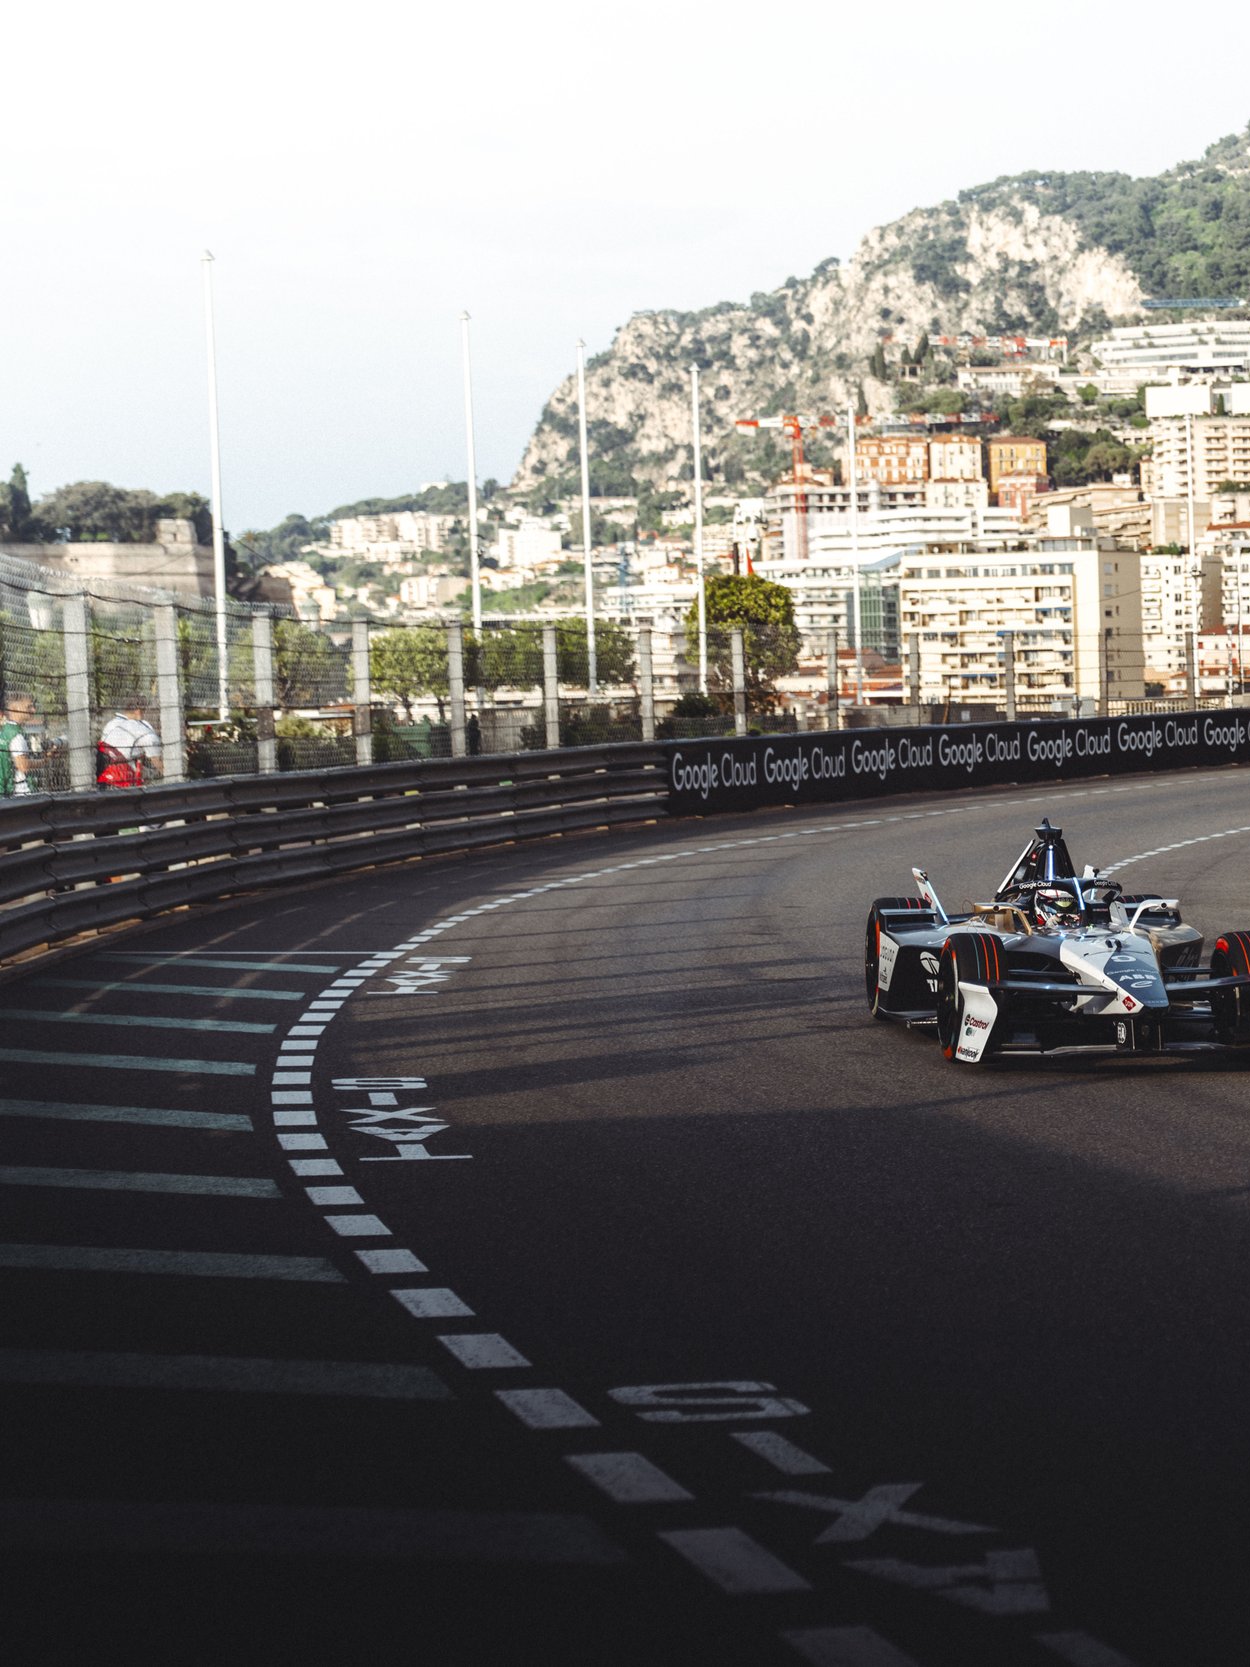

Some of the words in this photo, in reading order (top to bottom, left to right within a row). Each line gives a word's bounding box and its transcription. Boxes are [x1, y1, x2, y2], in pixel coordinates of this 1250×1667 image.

[939, 733, 983, 772] Google
[985, 732, 1020, 763] Cloud
[1027, 729, 1072, 767] Google
[1075, 728, 1111, 756] Cloud
[1118, 721, 1162, 757] Google
[1165, 720, 1198, 747] Cloud
[1203, 718, 1245, 752] Google
[672, 752, 718, 800] Google
[721, 752, 757, 788] Cloud
[764, 747, 809, 791] Google
[811, 747, 845, 779] Cloud
[851, 738, 896, 780] Google
[898, 737, 933, 768] Cloud
[1019, 880, 1037, 890] Google
[331, 1076, 474, 1162] TAXIS
